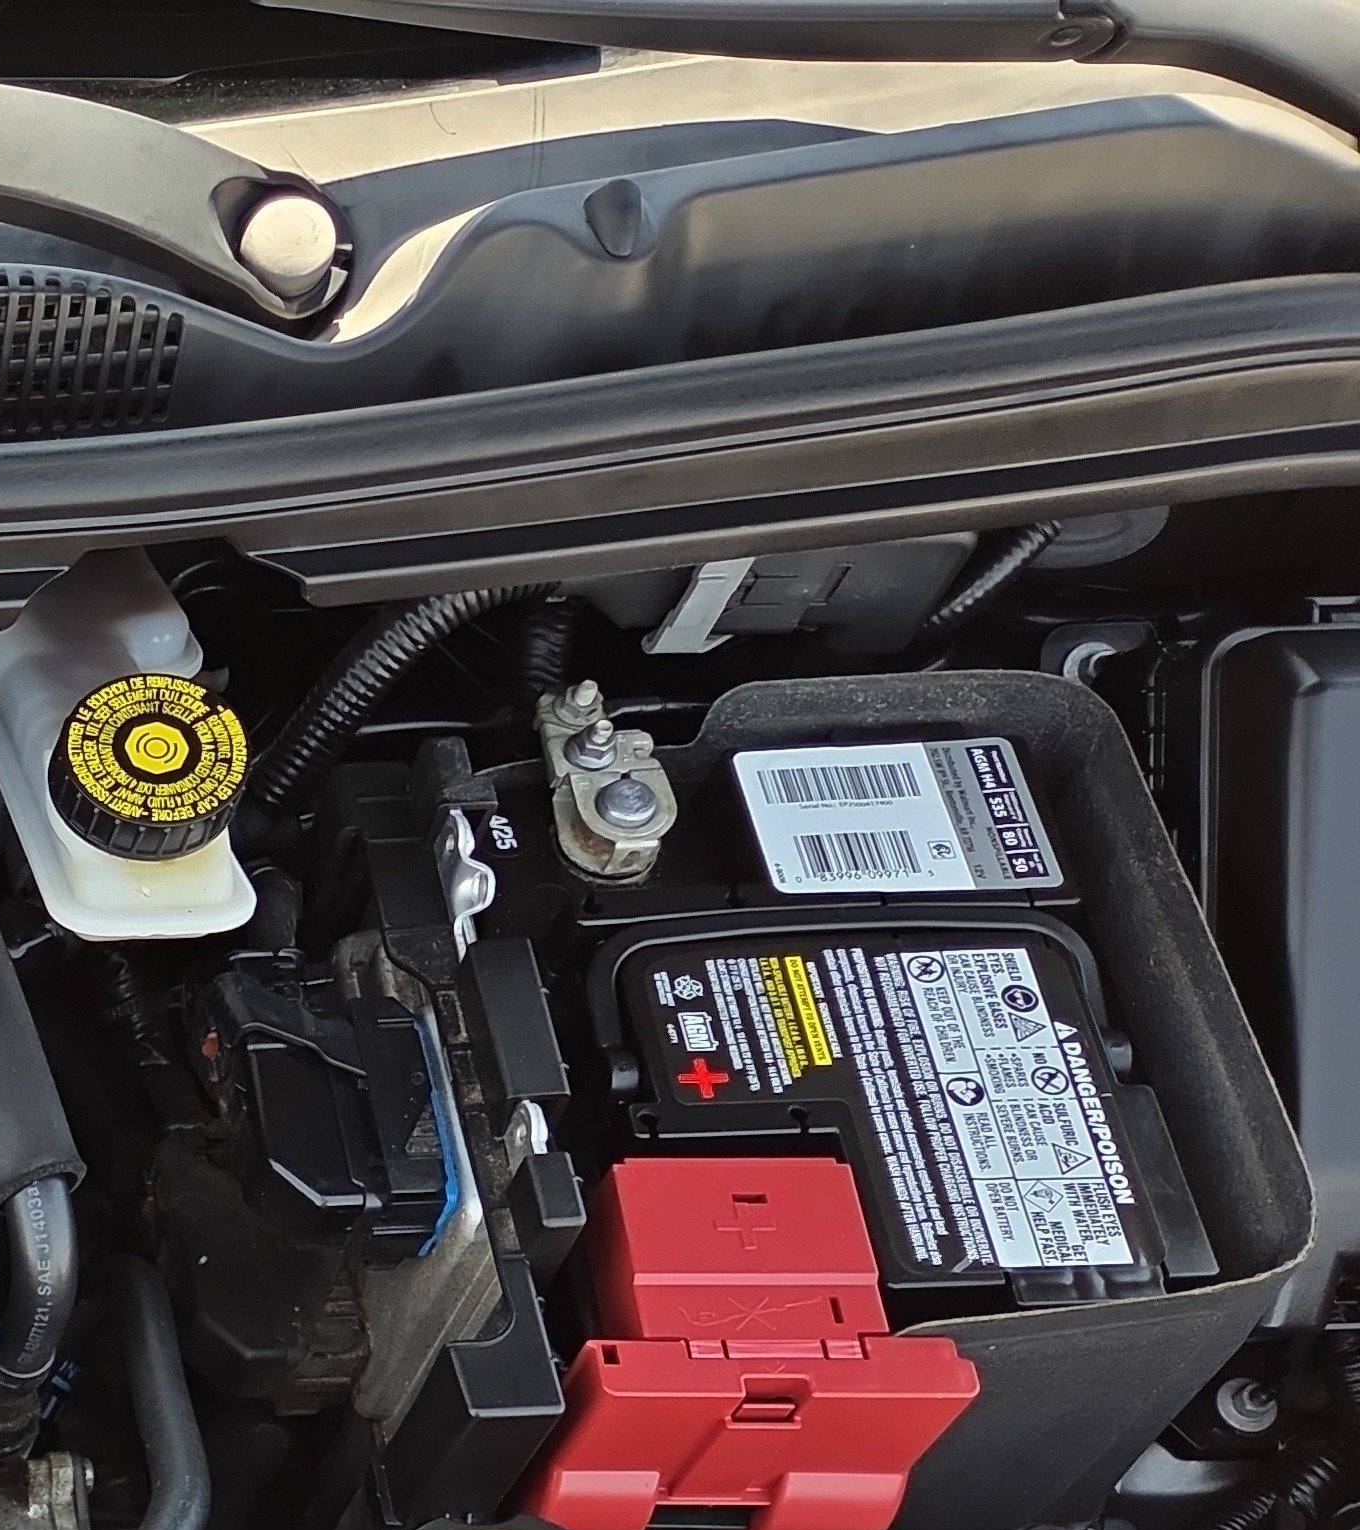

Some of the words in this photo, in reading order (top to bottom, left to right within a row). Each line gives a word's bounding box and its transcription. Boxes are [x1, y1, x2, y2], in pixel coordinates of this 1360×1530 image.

[76, 707, 93, 721] LE
[86, 681, 129, 711] BOUCHON
[130, 677, 145, 689] DE
[146, 676, 206, 700] REMPLISSAGE
[159, 689, 175, 701] DU
[174, 692, 210, 717] LIQUIDE
[108, 697, 161, 727] CONTENANT
[192, 721, 214, 743] FROM
[194, 751, 215, 778] SEALED
[210, 762, 228, 781] USE
[971, 749, 991, 772] AGM
[99, 775, 115, 789] DE
[129, 779, 137, 789] 4
[135, 781, 154, 795] DOT
[197, 778, 218, 797] ONLY
[213, 771, 242, 800] FILLER
[980, 774, 996, 788] H4
[112, 787, 146, 805] AVANT
[147, 796, 175, 808] FLUID
[182, 790, 200, 805] DOT
[197, 796, 218, 814] CAP
[989, 797, 1007, 817] 535
[152, 803, 195, 821] BEFORE
[489, 815, 518, 850] 4/25
[1002, 831, 1018, 846] 80
[986, 827, 1012, 879] NONSPILLABLE
[867, 868, 910, 880] 09971
[973, 864, 986, 879] 12V
[1012, 858, 1028, 872] 50
[946, 954, 958, 964] OR
[958, 954, 972, 968] CAN
[987, 953, 1004, 977] EYES.
[1002, 953, 1022, 981] SHIELD
[950, 967, 968, 993] INJURY.
[963, 971, 980, 994] CAUSE
[972, 953, 998, 999] EXPLOSIVE
[988, 1002, 1008, 1028] GASES
[922, 987, 940, 1011] REACH
[935, 987, 951, 1004] KEEP
[931, 1014, 943, 1023] OF
[942, 1007, 956, 1021] OUT
[972, 997, 995, 1037] BLINDNESS
[681, 1014, 710, 1047] AGM
[947, 1023, 960, 1032] OF
[934, 1025, 957, 1065] CHILDREN.
[951, 1035, 966, 1049] THE
[1032, 1053, 1047, 1064] NO
[976, 1112, 992, 1132] READ
[1024, 1104, 1038, 1119] CAN
[1038, 1104, 1055, 1124] ACID
[1010, 1104, 1034, 1147] BLINDNESS
[1025, 1149, 1038, 1161] OR
[1030, 1121, 1048, 1146] CAUSE
[1053, 1103, 1079, 1146] SULFURIC
[1063, 1042, 1135, 1204] DANGER/POISON
[963, 1113, 991, 1172] INSTRUCTIONS.
[983, 1135, 997, 1149] ALL
[996, 1105, 1015, 1133] SEVERE
[1006, 1136, 1025, 1165] BURNS.
[985, 1183, 1002, 1204] OPEN
[999, 1182, 1012, 1193] DO
[1063, 1183, 1082, 1206] WITH
[1092, 1182, 1113, 1210] FLUSH
[1003, 1196, 1019, 1211] NOT
[1078, 1183, 1110, 1245] IMMEDIATELY
[993, 1206, 1014, 1242] BATTERY.
[1030, 1211, 1049, 1234] HELP
[1072, 1210, 1094, 1245] WATER.
[1102, 1214, 1122, 1237] EYES
[1039, 1237, 1059, 1263] FAST.
[1048, 1221, 1073, 1263] MEDICAL
[1071, 1245, 1088, 1262] GET
[37, 1259, 53, 1297] SAE
